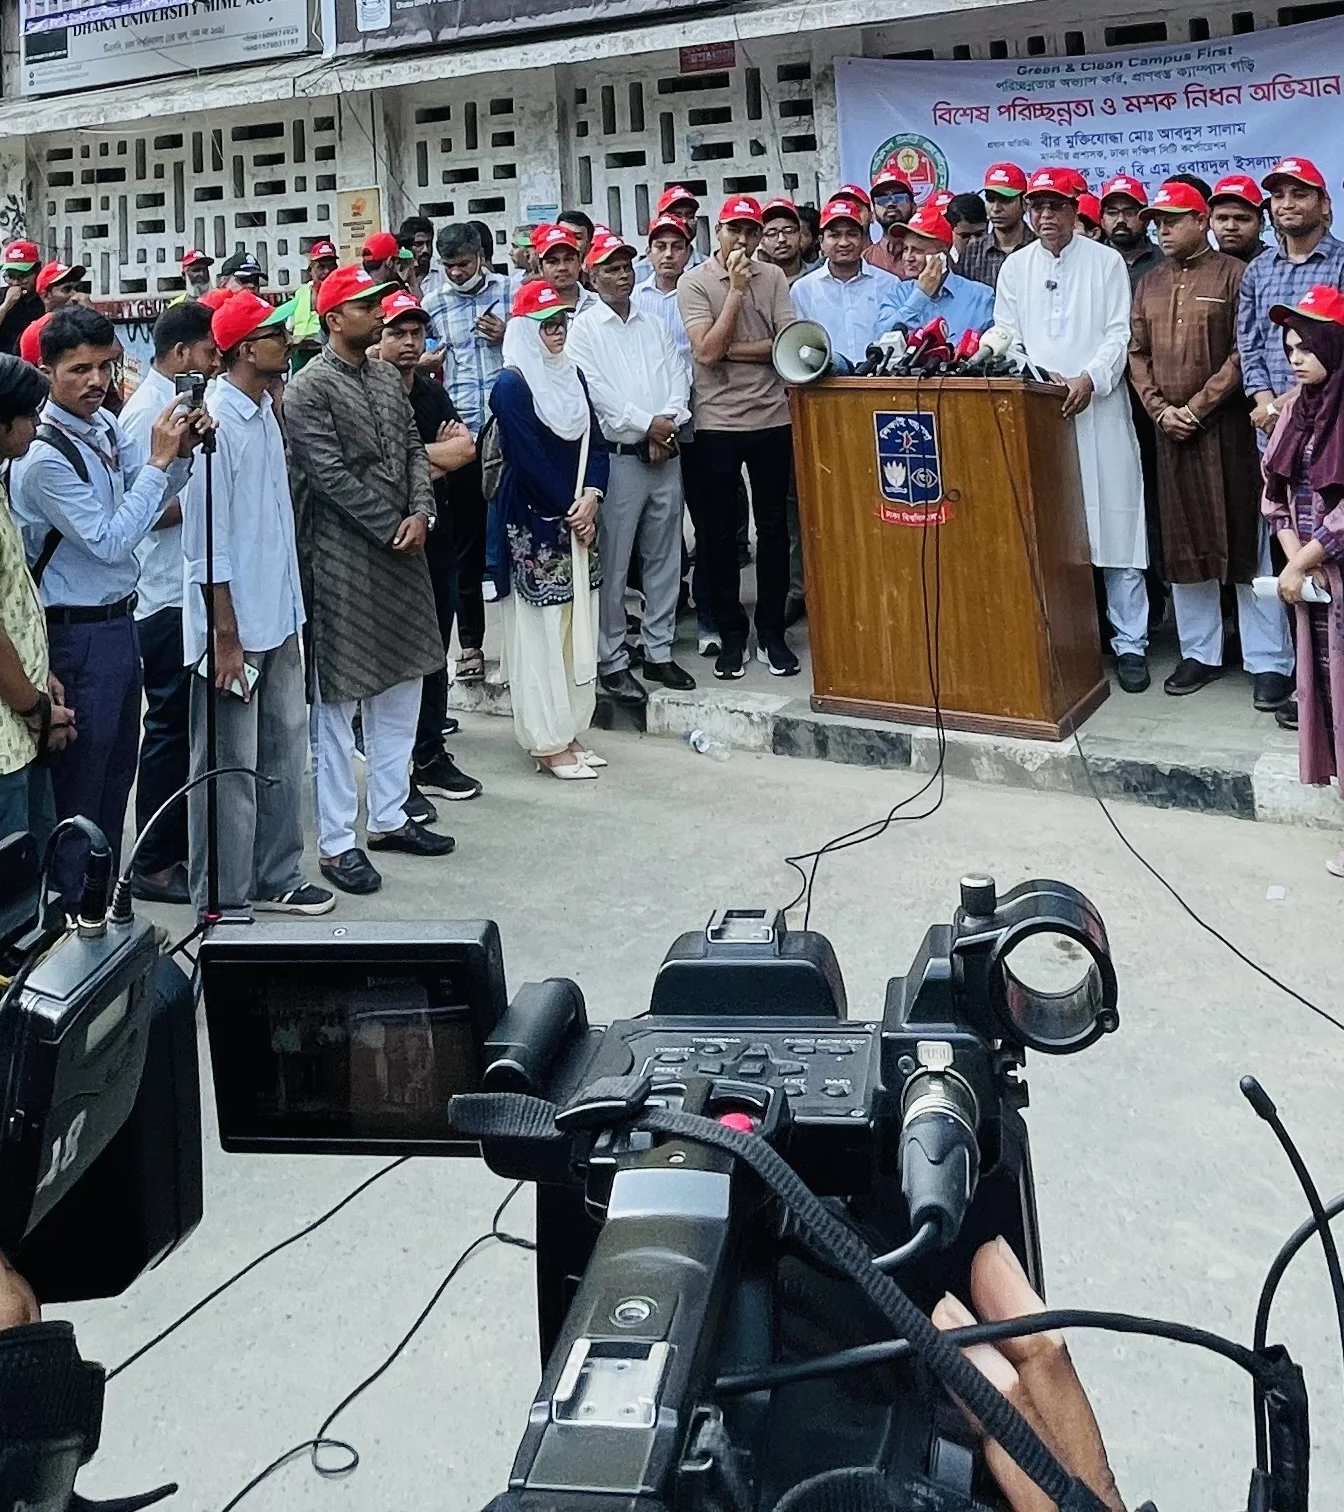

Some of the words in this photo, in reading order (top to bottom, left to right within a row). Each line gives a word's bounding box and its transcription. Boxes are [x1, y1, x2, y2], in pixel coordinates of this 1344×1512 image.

[1016, 63, 1062, 76] Green
[1064, 62, 1077, 74] &
[1080, 59, 1124, 73] Clean
[1127, 51, 1193, 69] Campus
[1196, 45, 1234, 60] First
[1230, 55, 1256, 74] গড়ি
[931, 100, 991, 126] বিশেষ
[996, 95, 1096, 128] পরিচ্ছন্নতা
[1099, 96, 1118, 117] ও
[1121, 91, 1178, 114] মশক
[1182, 81, 1244, 111] নিধন
[1247, 72, 1342, 104] অভিযান
[1039, 131, 1062, 149] বীর
[1064, 129, 1125, 150] মুক্তিযোদ্ধা
[1127, 129, 1155, 146] মোঃ
[1156, 124, 1203, 142] আবদুস
[1206, 121, 1248, 137] সালাম
[1109, 146, 1130, 159] ঢাকা
[1158, 141, 1178, 154] সিটি
[1180, 138, 1228, 154] কর্পোরেশন
[1094, 167, 1111, 180] ড.
[1115, 160, 1127, 176] এ
[1131, 160, 1146, 178] বি
[1149, 161, 1171, 176] এম
[1175, 155, 1230, 176] ওবায়দুল
[1232, 153, 1283, 172] ইসলাম
